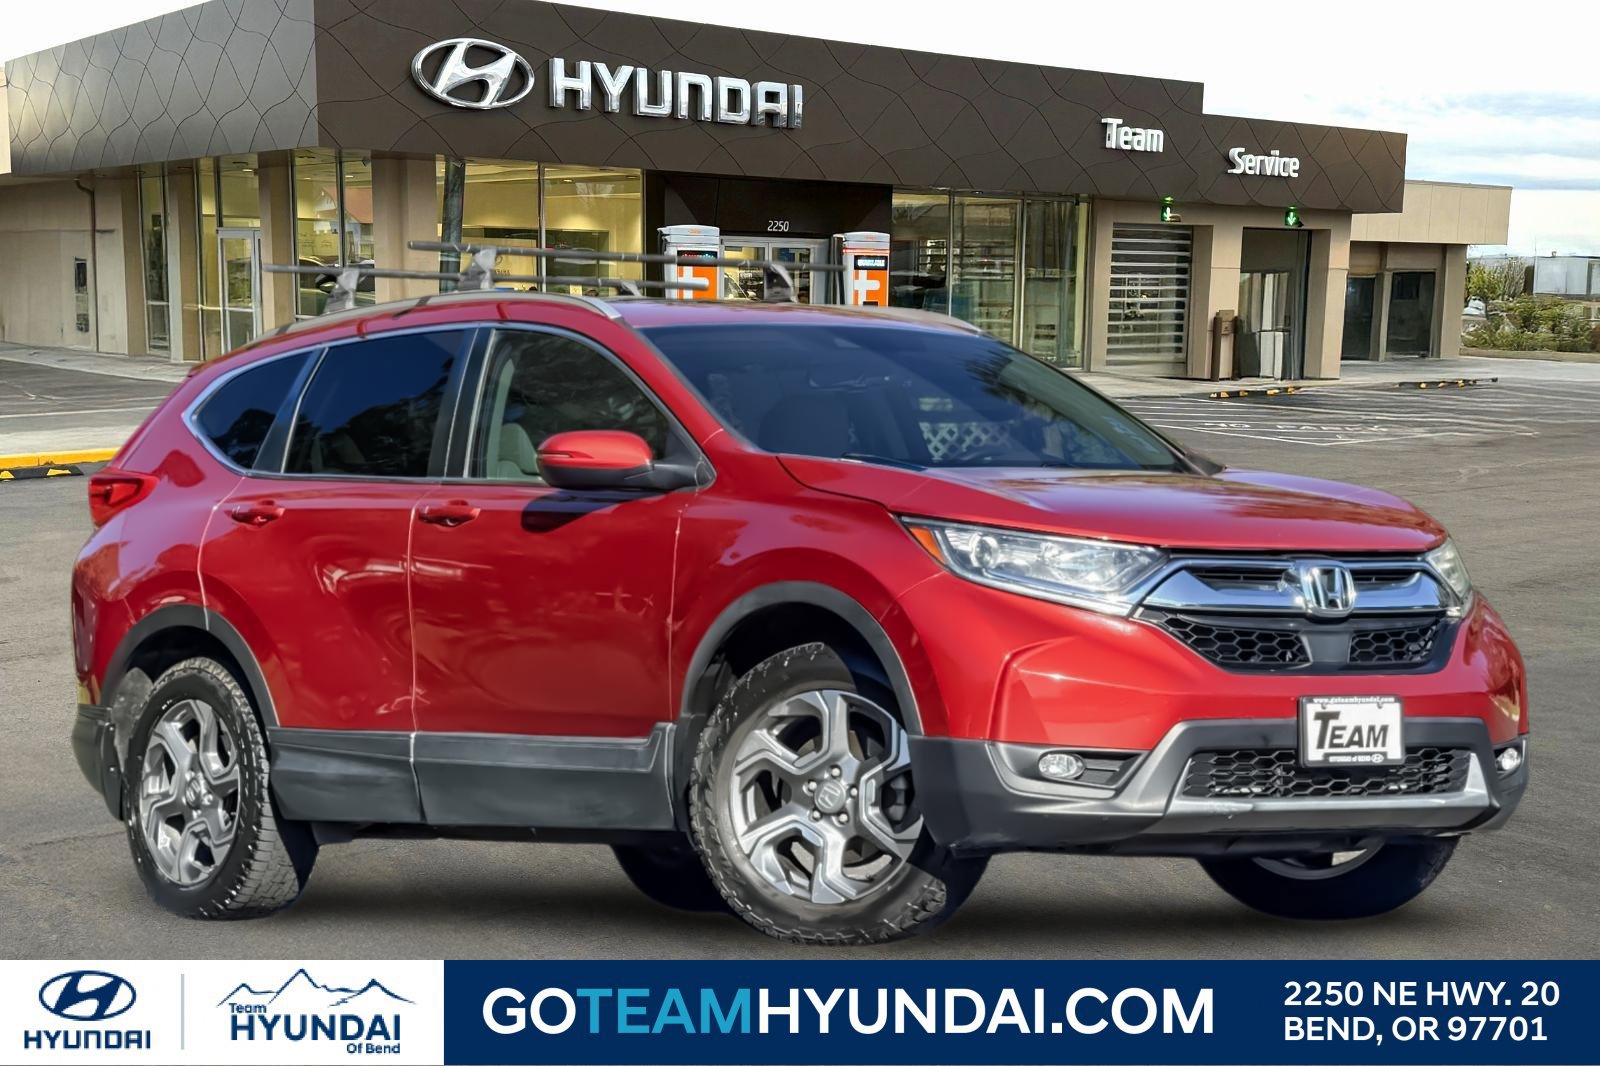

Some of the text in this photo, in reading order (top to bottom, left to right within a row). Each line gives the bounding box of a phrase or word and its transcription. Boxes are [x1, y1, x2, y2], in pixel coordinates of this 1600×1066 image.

[550, 58, 804, 128] HYUNDAI
[1101, 117, 1164, 153] Team
[1227, 146, 1300, 178] Service
[767, 220, 790, 232] 2250
